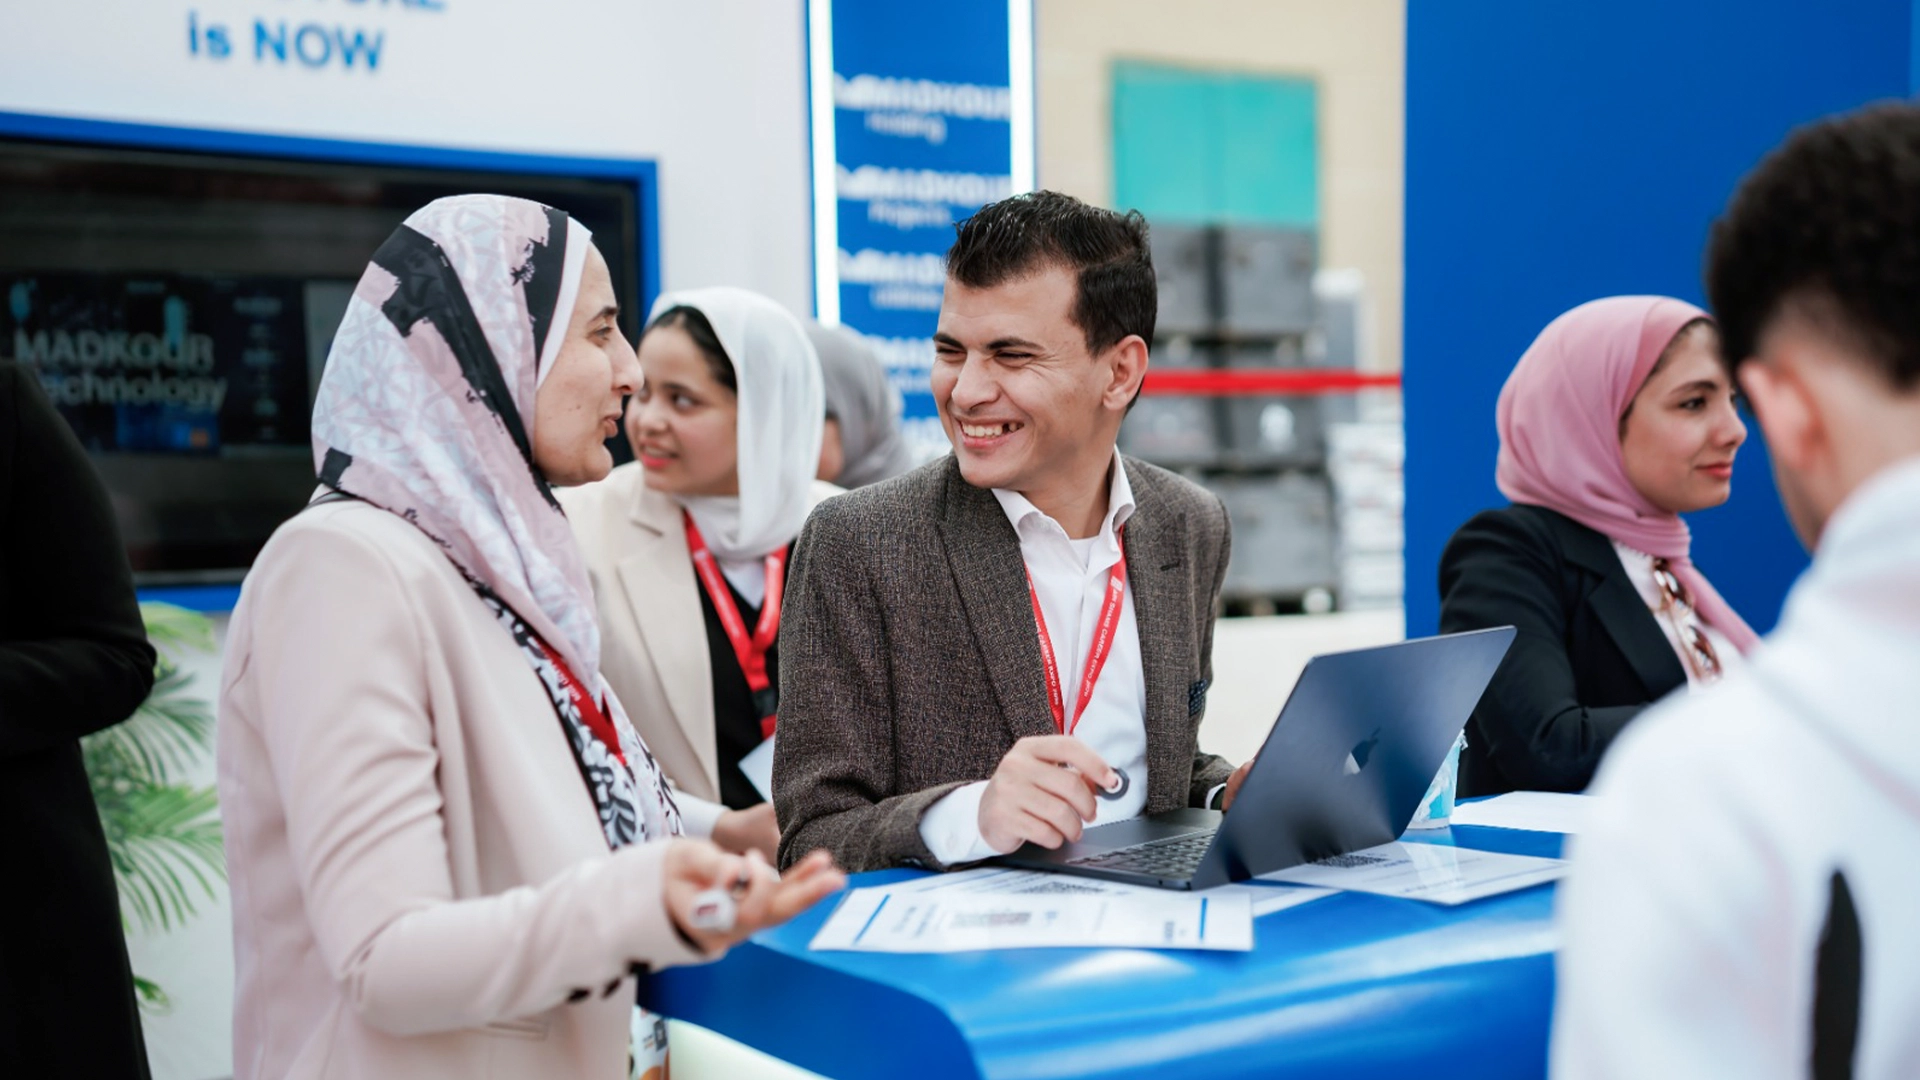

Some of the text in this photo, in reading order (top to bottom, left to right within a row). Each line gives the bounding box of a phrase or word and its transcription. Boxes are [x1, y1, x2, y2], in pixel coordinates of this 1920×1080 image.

[187, 9, 386, 71] is NOW
[13, 328, 215, 374] MADKOUR
[40, 369, 228, 414] echnology
[1095, 628, 1108, 659] CAREER
